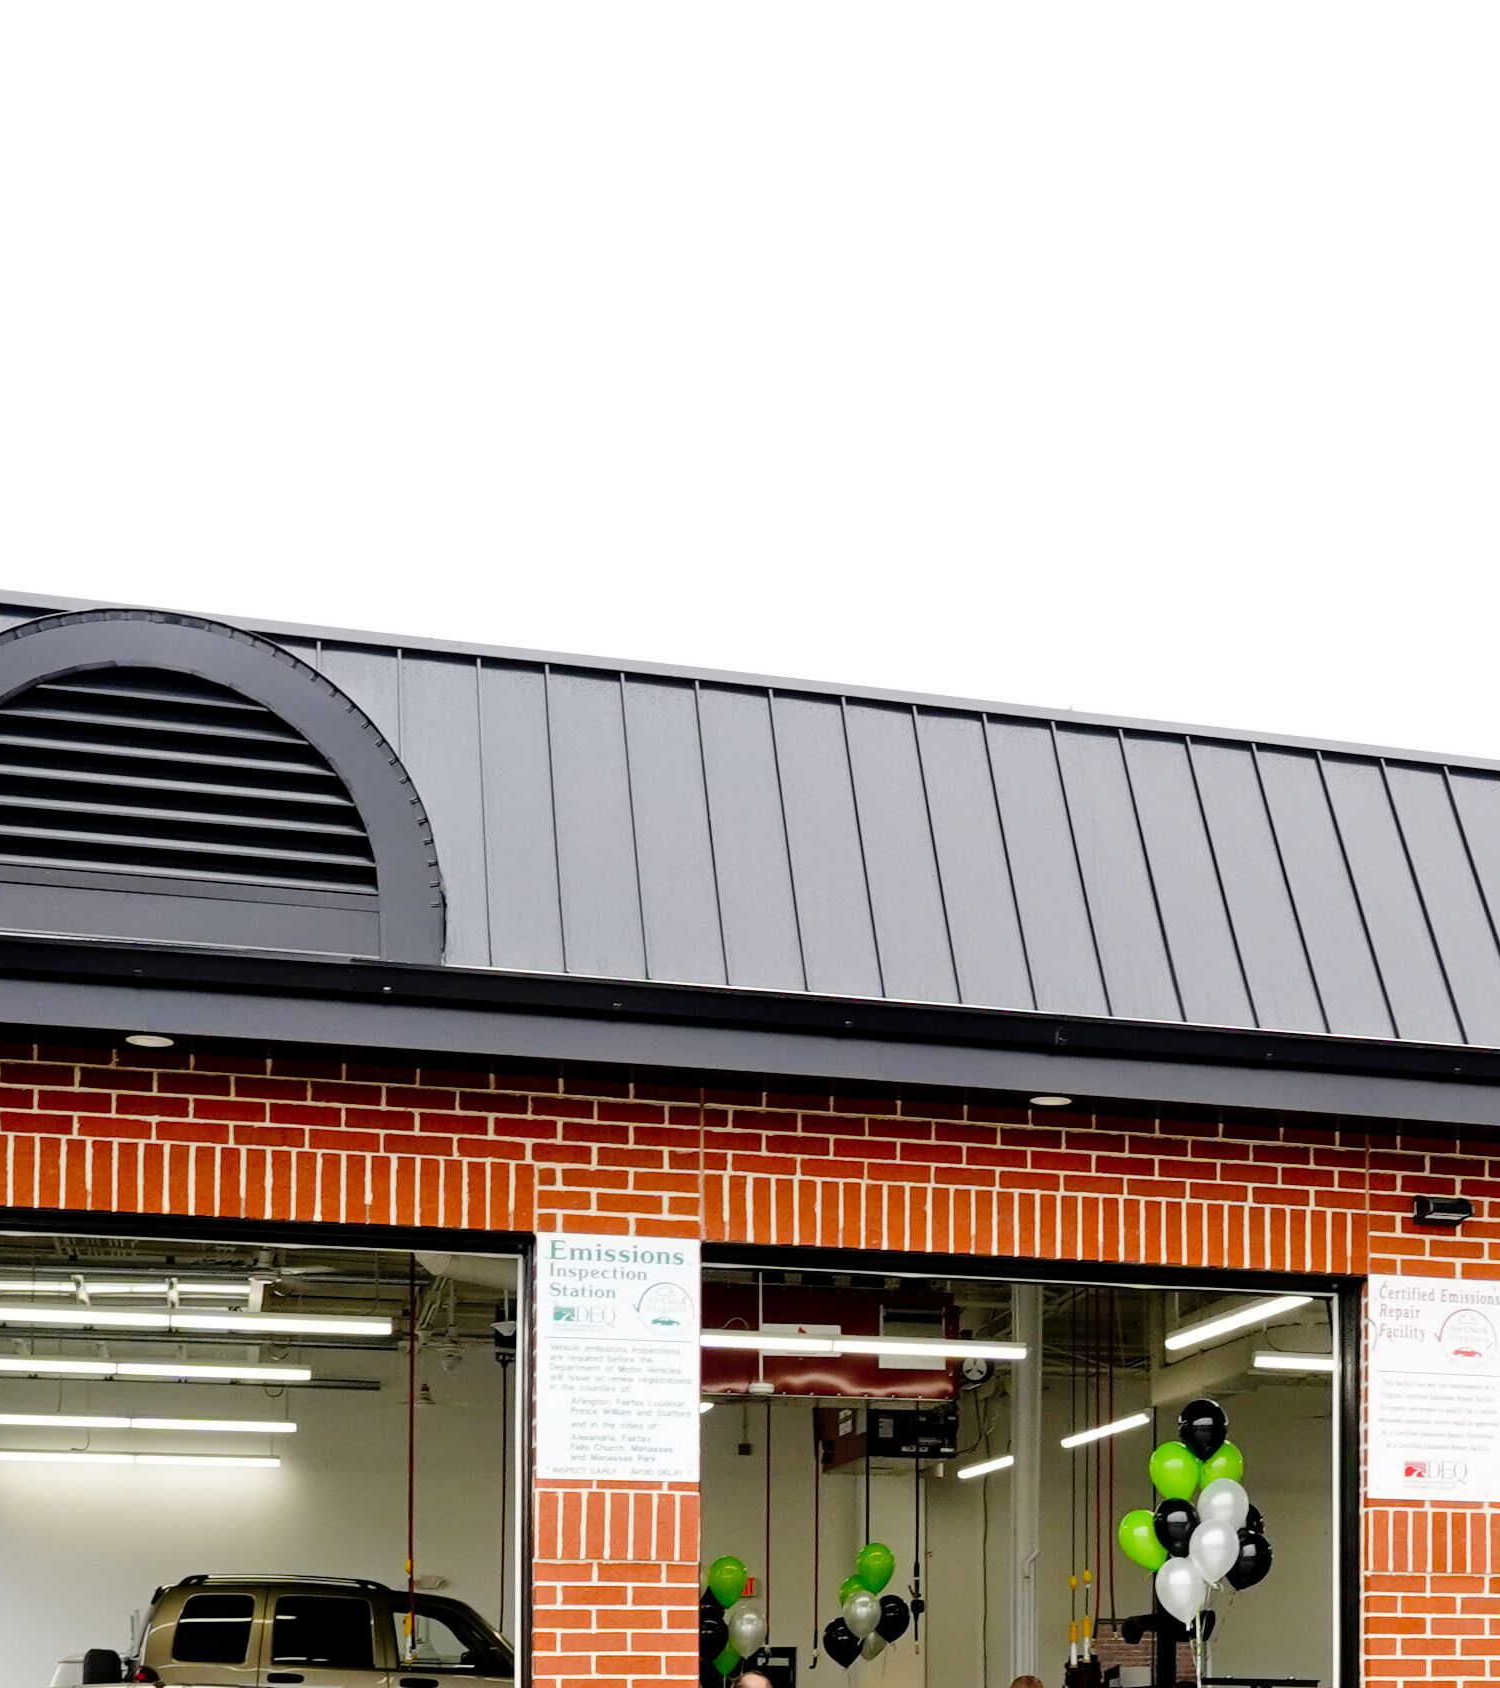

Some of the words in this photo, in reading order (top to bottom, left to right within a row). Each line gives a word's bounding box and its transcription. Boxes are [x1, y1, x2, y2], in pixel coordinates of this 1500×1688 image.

[549, 1239, 684, 1265] Emissions
[549, 1262, 647, 1282] Inspection
[549, 1282, 616, 1299] Station
[1379, 1284, 1435, 1302] Certified
[576, 1305, 616, 1328] DEQ
[1379, 1304, 1421, 1321] Repair
[1379, 1324, 1426, 1342] Facility
[1428, 1460, 1468, 1485] DEQ
